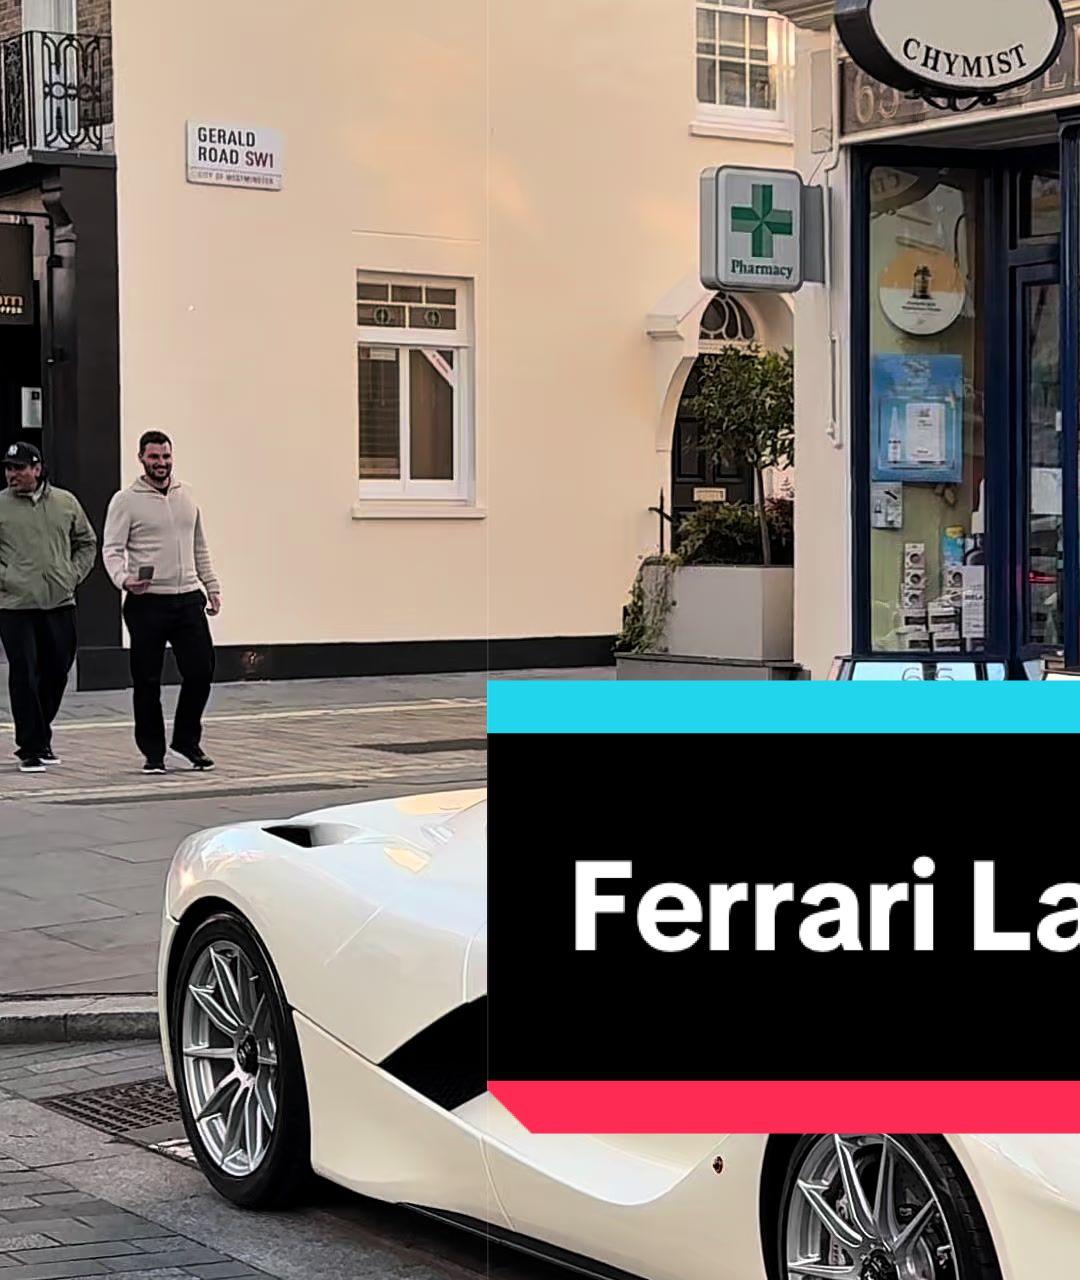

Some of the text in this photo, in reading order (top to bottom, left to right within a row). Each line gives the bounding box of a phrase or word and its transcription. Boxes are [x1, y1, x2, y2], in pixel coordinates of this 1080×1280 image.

[903, 38, 1027, 78] CHYMIST
[198, 127, 255, 147] GERALD
[199, 146, 273, 168] ROAD SW1
[731, 259, 793, 279] Pharmacy
